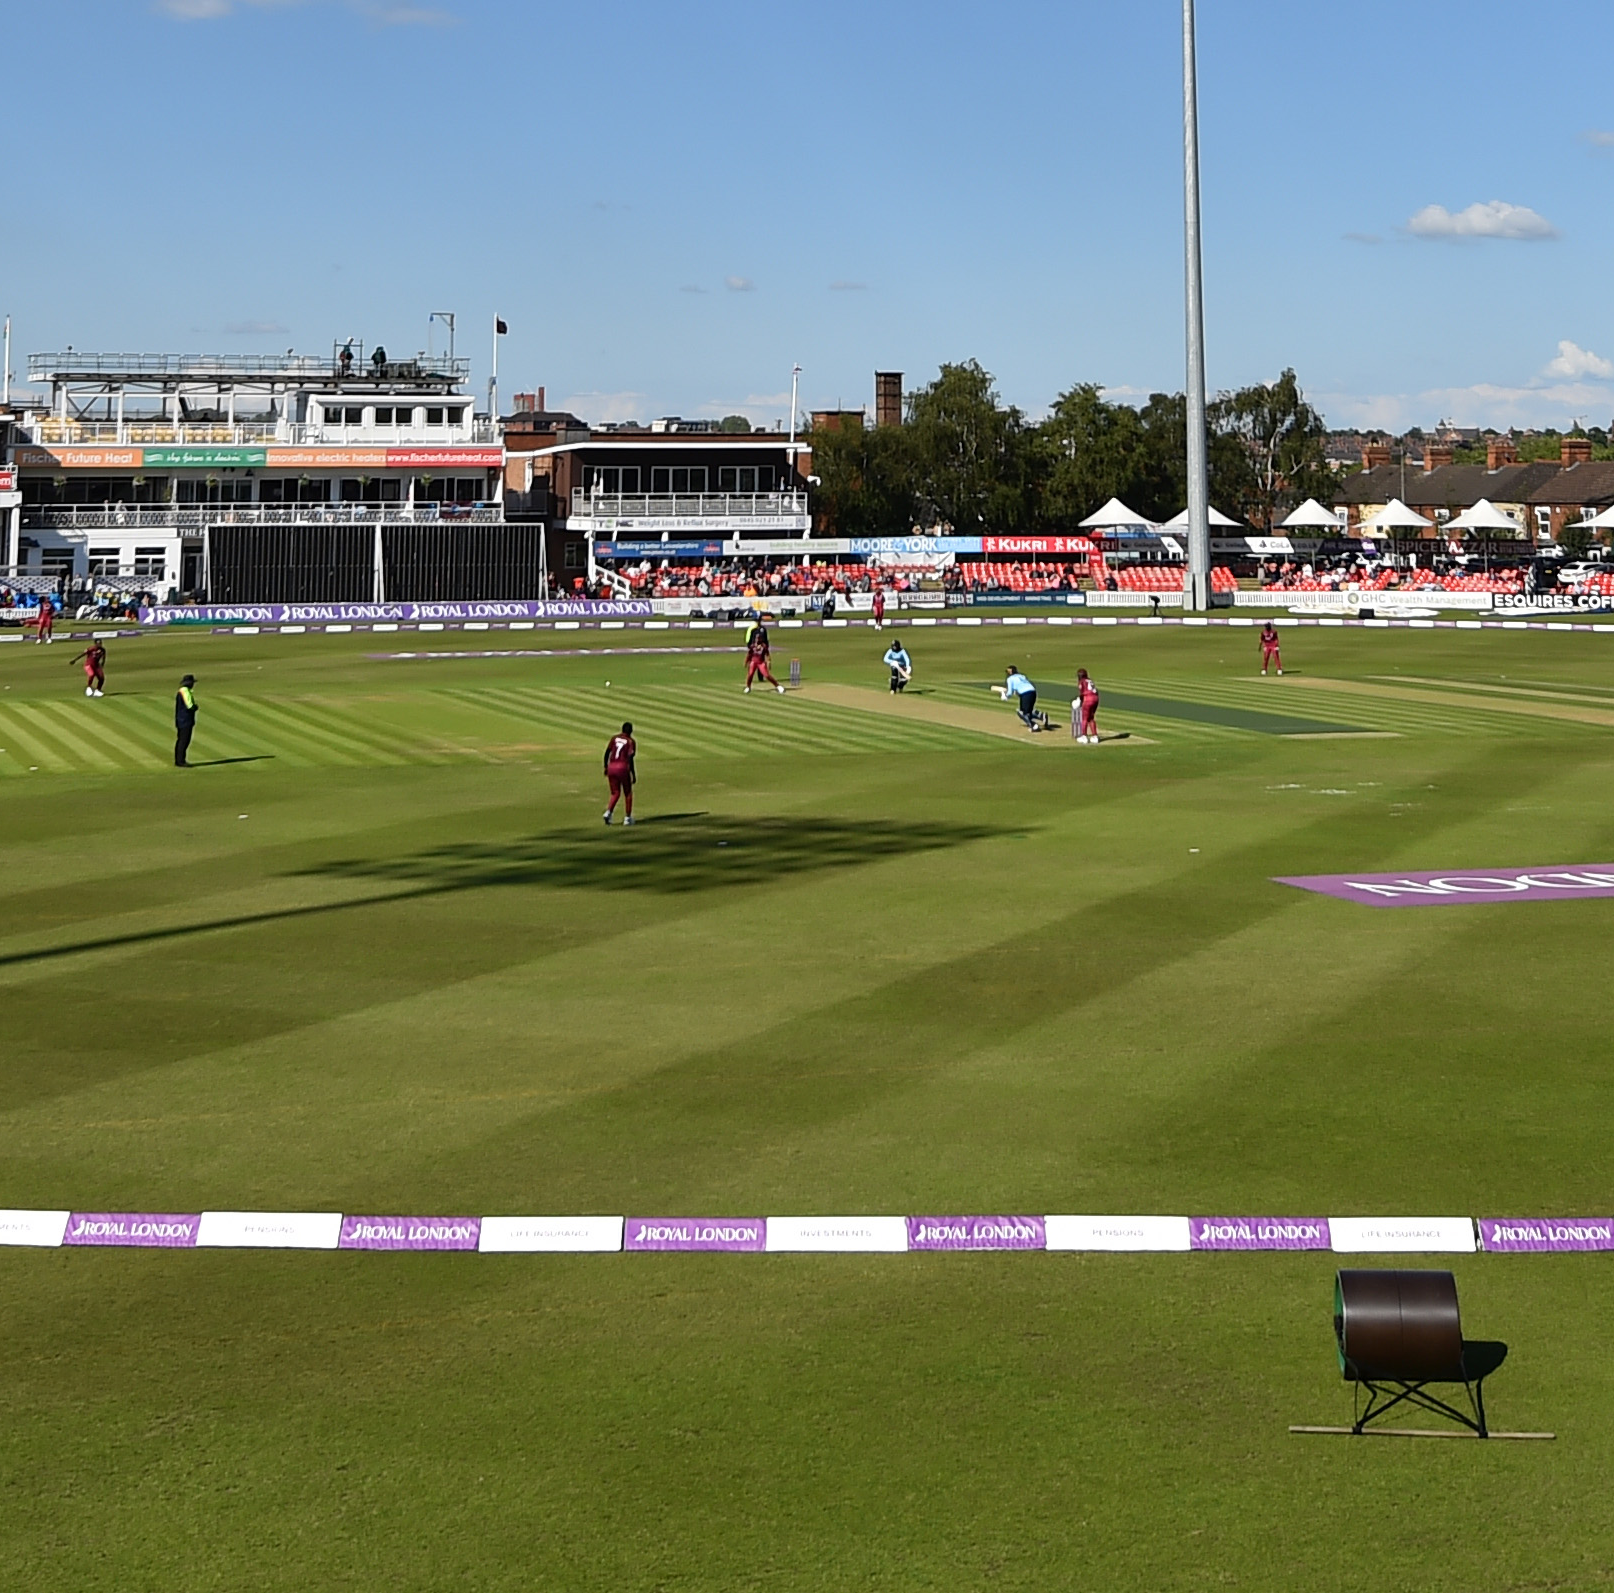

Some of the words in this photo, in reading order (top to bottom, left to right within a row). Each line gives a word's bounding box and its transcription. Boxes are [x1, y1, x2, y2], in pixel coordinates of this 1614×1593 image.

[22, 453, 63, 464] Fischer
[66, 452, 101, 464] Future
[105, 453, 132, 464] Heat
[267, 453, 314, 463] Innovative
[316, 453, 349, 463] electric
[352, 453, 386, 463] heaters
[387, 452, 502, 463] www.fischerfutureheat.com
[850, 537, 893, 552] MOORE
[904, 537, 937, 551] YORK
[999, 538, 1047, 550] KUKRI
[1066, 538, 1116, 550] KUKRI
[1397, 541, 1436, 553] SPICE
[1361, 594, 1386, 604] GHC
[1389, 595, 1423, 605] Wealth
[1425, 596, 1487, 607] Management
[1494, 593, 1574, 608] ESQUIRES
[157, 608, 200, 621] ROYAL
[207, 607, 273, 621] LONDON
[293, 606, 339, 619] ROYAL
[341, 606, 403, 618] LONDON
[421, 605, 466, 617] ROYAL
[468, 605, 528, 617] LONDON
[547, 602, 590, 615] ROYAL
[592, 601, 653, 614] LONDON
[85, 1220, 128, 1236] ROYAL
[130, 1221, 192, 1237] LONDON
[362, 1224, 405, 1240] ROYAL
[408, 1225, 471, 1241] LONDON
[647, 1225, 691, 1241] ROYAL
[694, 1226, 758, 1242] LONDON
[800, 1229, 872, 1237] INVESTMENTS
[925, 1225, 971, 1241] ROYAL
[973, 1224, 1037, 1240] LONDON
[1092, 1229, 1144, 1237] PENSIONS
[1211, 1225, 1255, 1241] ROYAL
[1257, 1223, 1320, 1240] LONDON
[1361, 1230, 1381, 1238] LIFE
[1383, 1230, 1442, 1238] INSURANCE
[1502, 1225, 1546, 1242] ROYAL
[1549, 1224, 1611, 1242] LONDON
